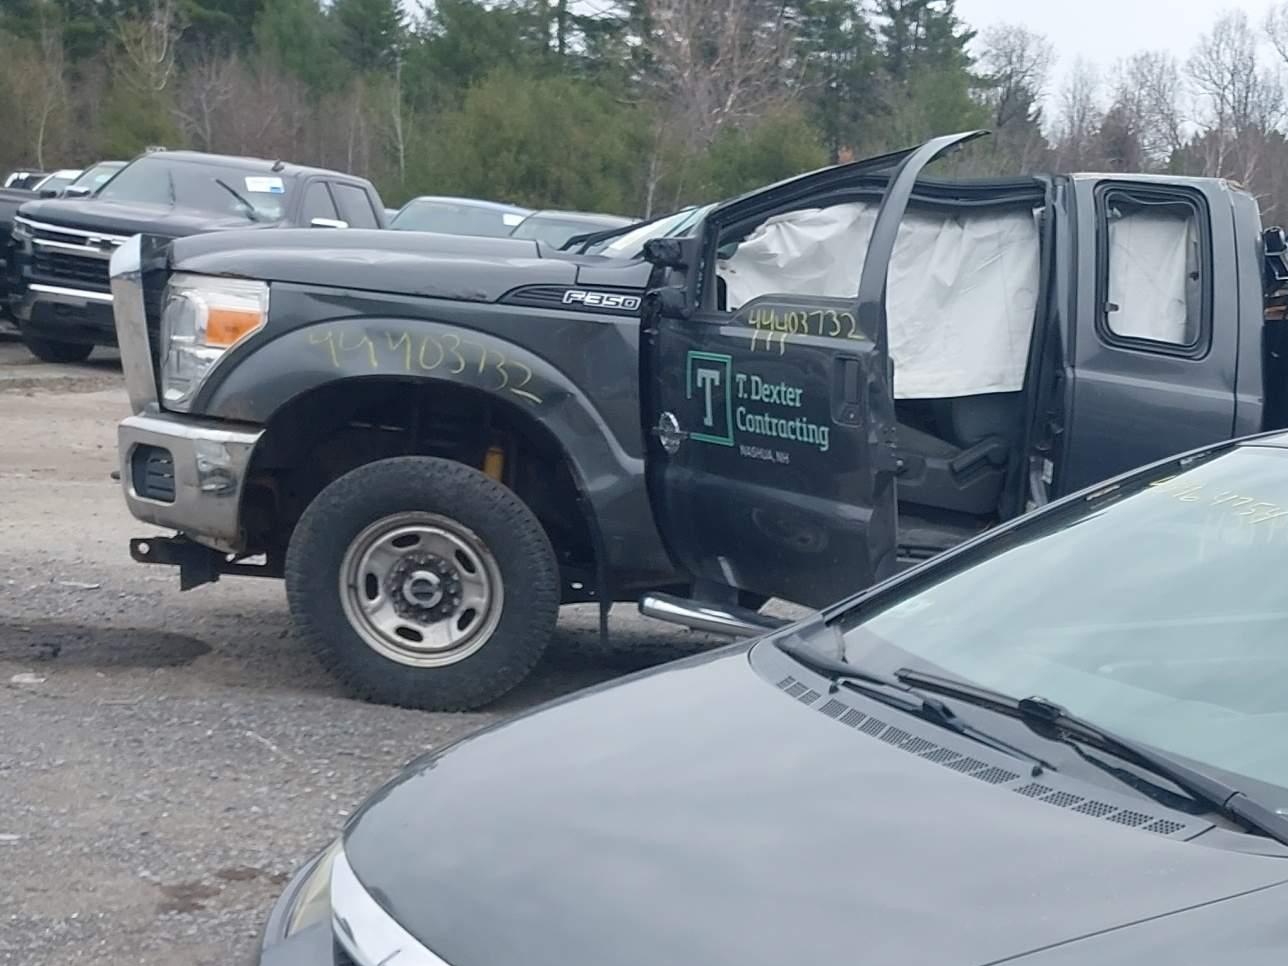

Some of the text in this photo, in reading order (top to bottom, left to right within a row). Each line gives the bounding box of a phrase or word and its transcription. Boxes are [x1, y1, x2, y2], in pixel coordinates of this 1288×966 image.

[562, 290, 642, 311] F350
[735, 373, 803, 408] T. Dexter
[736, 405, 830, 452] Contracting
